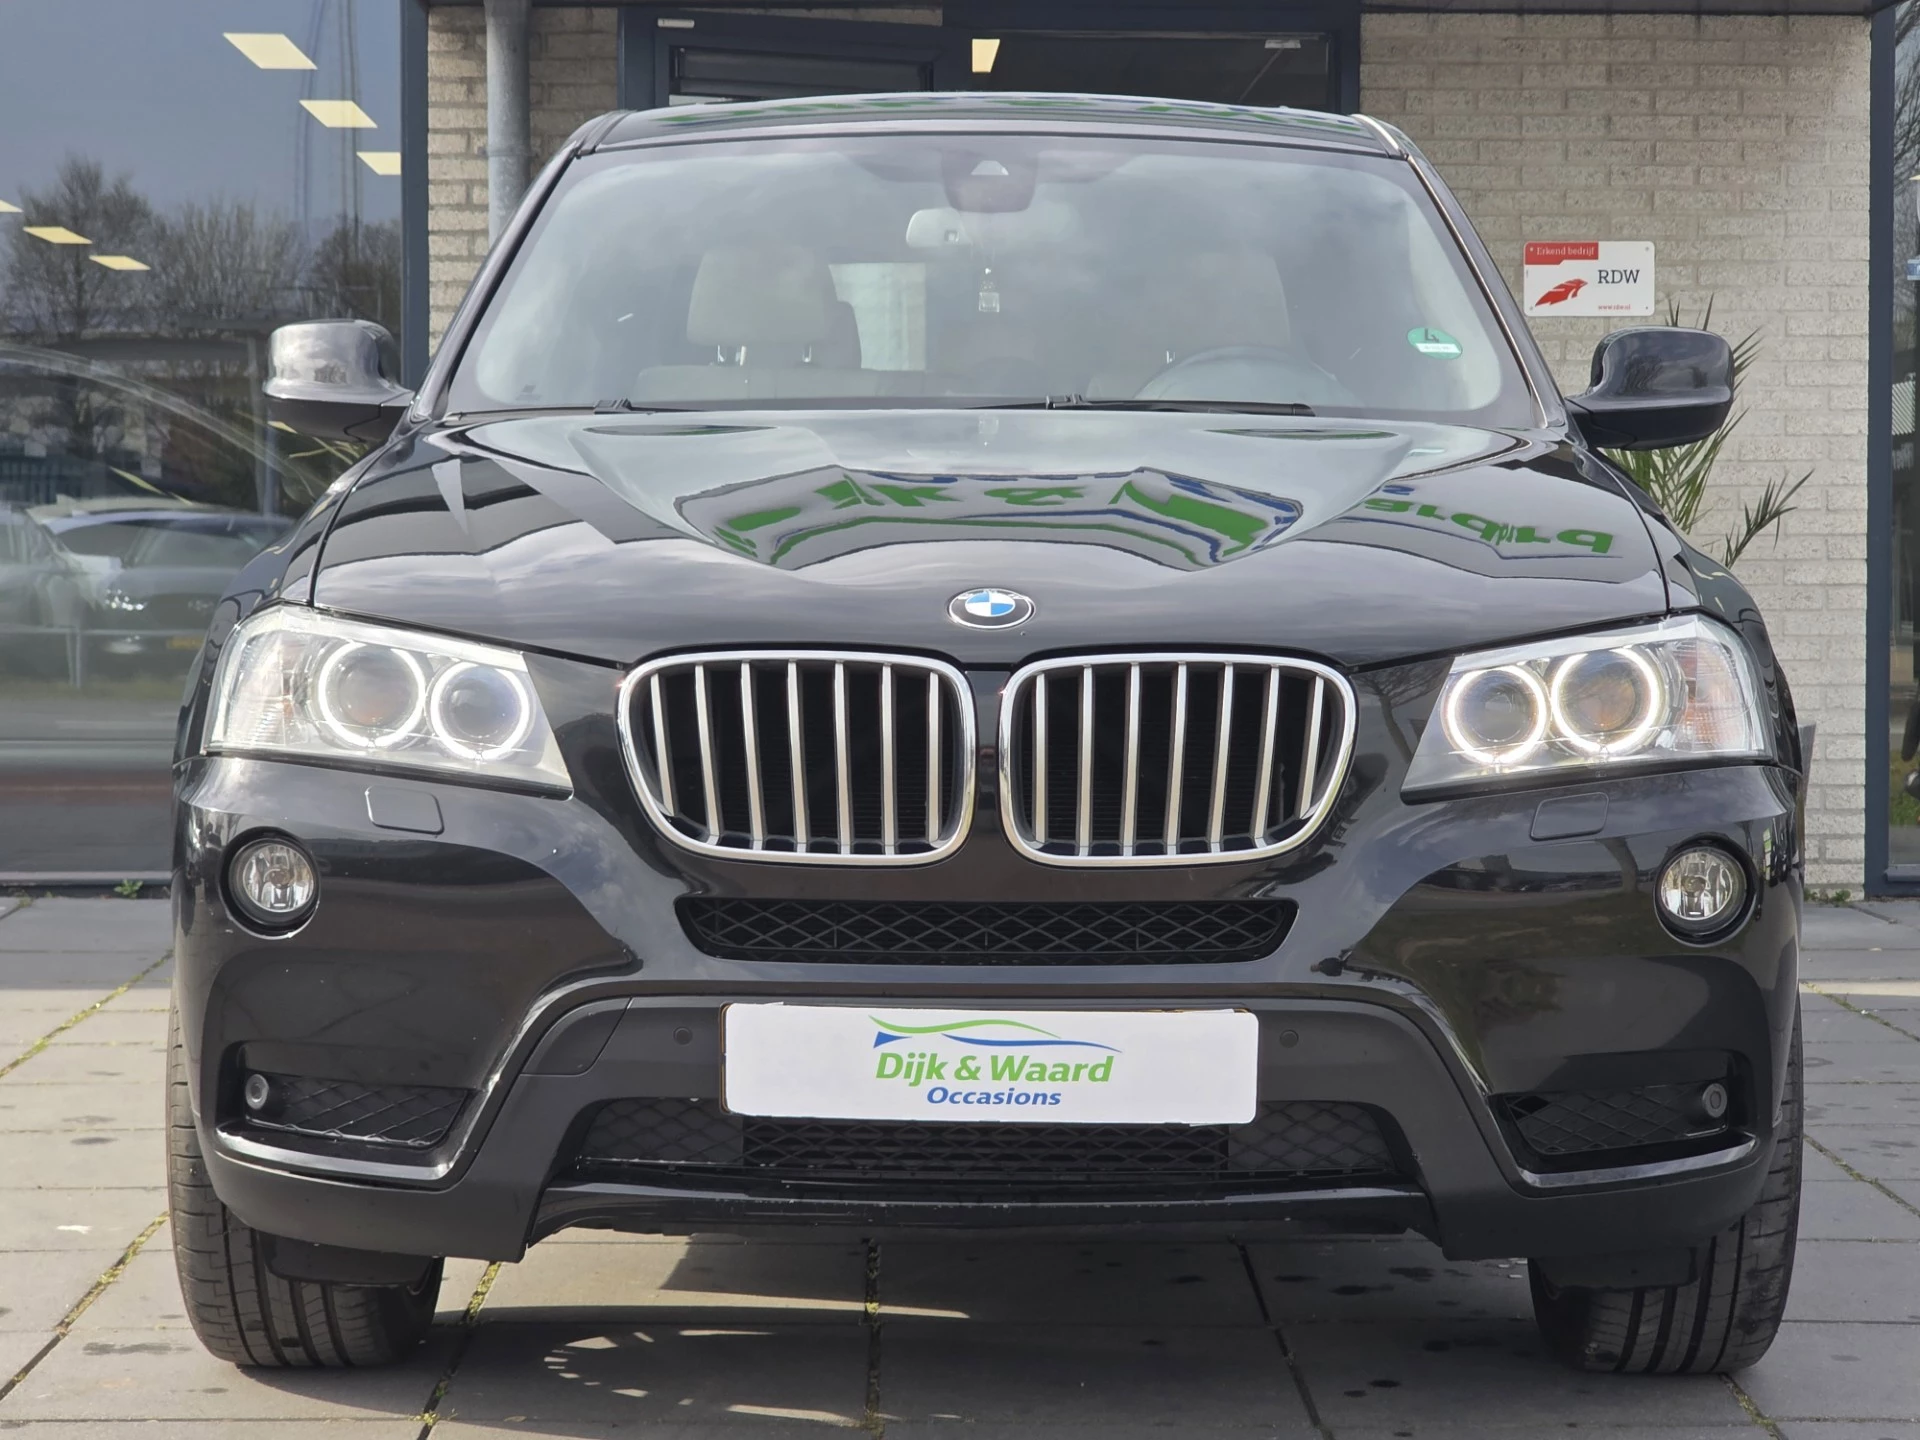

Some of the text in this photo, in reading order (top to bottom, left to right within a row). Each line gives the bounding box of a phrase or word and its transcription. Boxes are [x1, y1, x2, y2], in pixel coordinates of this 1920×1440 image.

[1536, 246, 1595, 257] Erkend bedrijf
[1597, 269, 1640, 284] RDW
[876, 1052, 1115, 1087] Dijk & Waard
[927, 1086, 1062, 1106] Occasions
